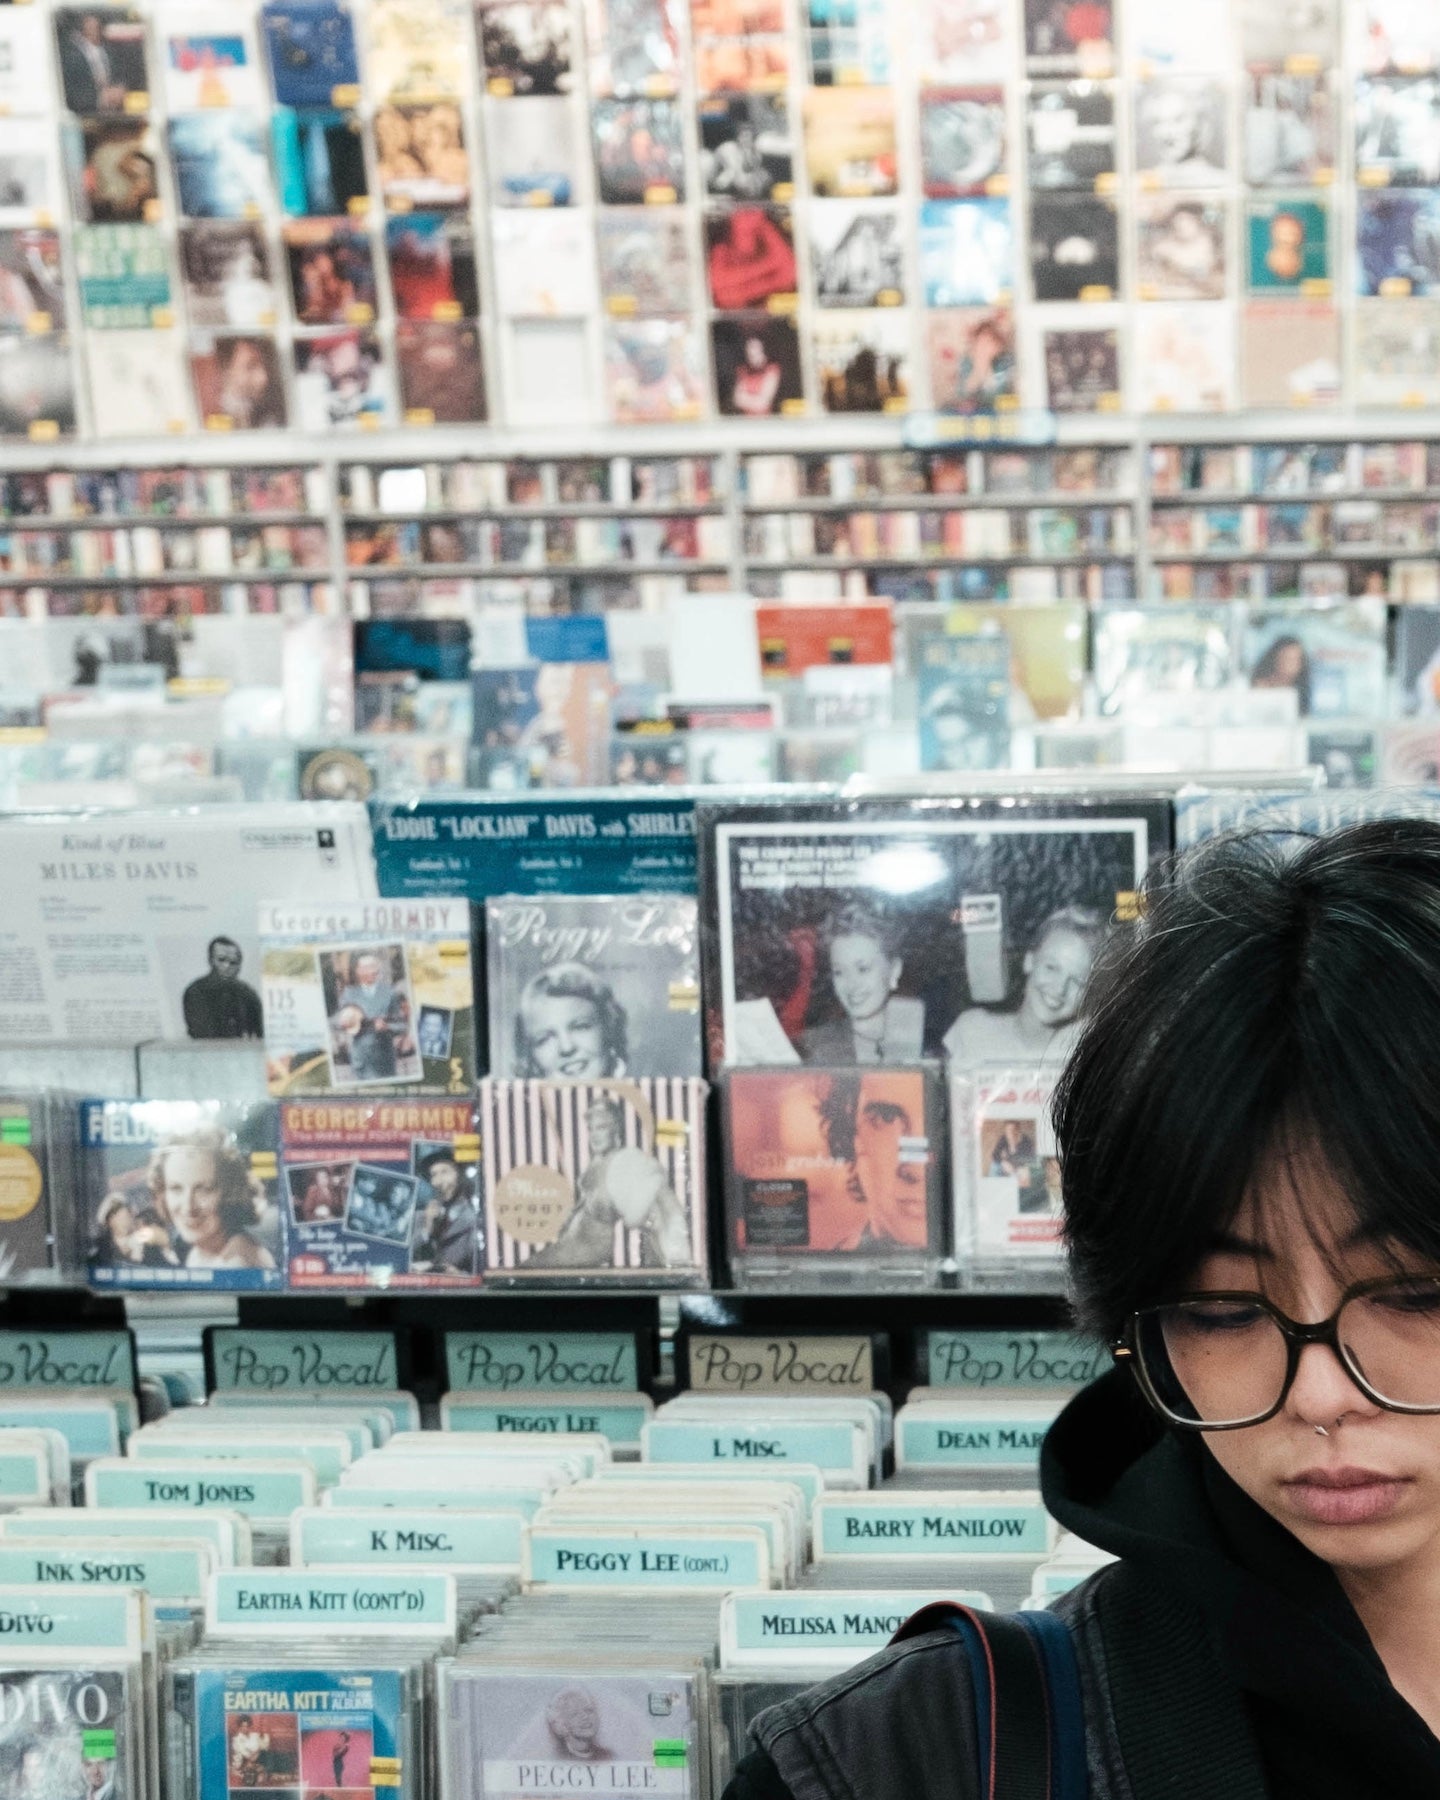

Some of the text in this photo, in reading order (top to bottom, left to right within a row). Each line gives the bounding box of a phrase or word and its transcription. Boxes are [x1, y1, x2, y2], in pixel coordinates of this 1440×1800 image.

[386, 815, 438, 840] EDDIE
[545, 813, 597, 838] DAVIS
[41, 860, 200, 881] MILES DAVIS
[271, 907, 451, 932] George FORMBY
[499, 904, 611, 961] Peggy
[287, 1107, 469, 1131] GEORGE FORMBY
[18, 1341, 119, 1386] Vocal
[222, 1342, 389, 1389] Pop Vocal
[457, 1341, 626, 1391] Pop Vocal
[695, 1341, 867, 1390] Pop Vocal
[935, 1338, 1102, 1387] Pop Vocal
[495, 1413, 600, 1432] PEGGY LEE
[712, 1438, 788, 1458] L MISC.
[937, 1429, 1048, 1449] DEAN MAR
[145, 1480, 256, 1506] TOM JONES
[844, 1516, 1027, 1538] BARRY MANILOW
[370, 1530, 453, 1552] K MISC.
[36, 1560, 146, 1582] INK SPOTS
[556, 1549, 729, 1574] PEGGY LEE (CONT.)
[236, 1587, 425, 1612] EARTHA KITT (CONT'D)
[0, 1610, 54, 1634] DIVO
[761, 1613, 912, 1636] MELISSA MANCH
[0, 1683, 109, 1725] DIVO
[224, 1690, 290, 1710] EARTHA
[293, 1690, 330, 1710] KITT
[517, 1764, 657, 1788] PEGGY LEE
